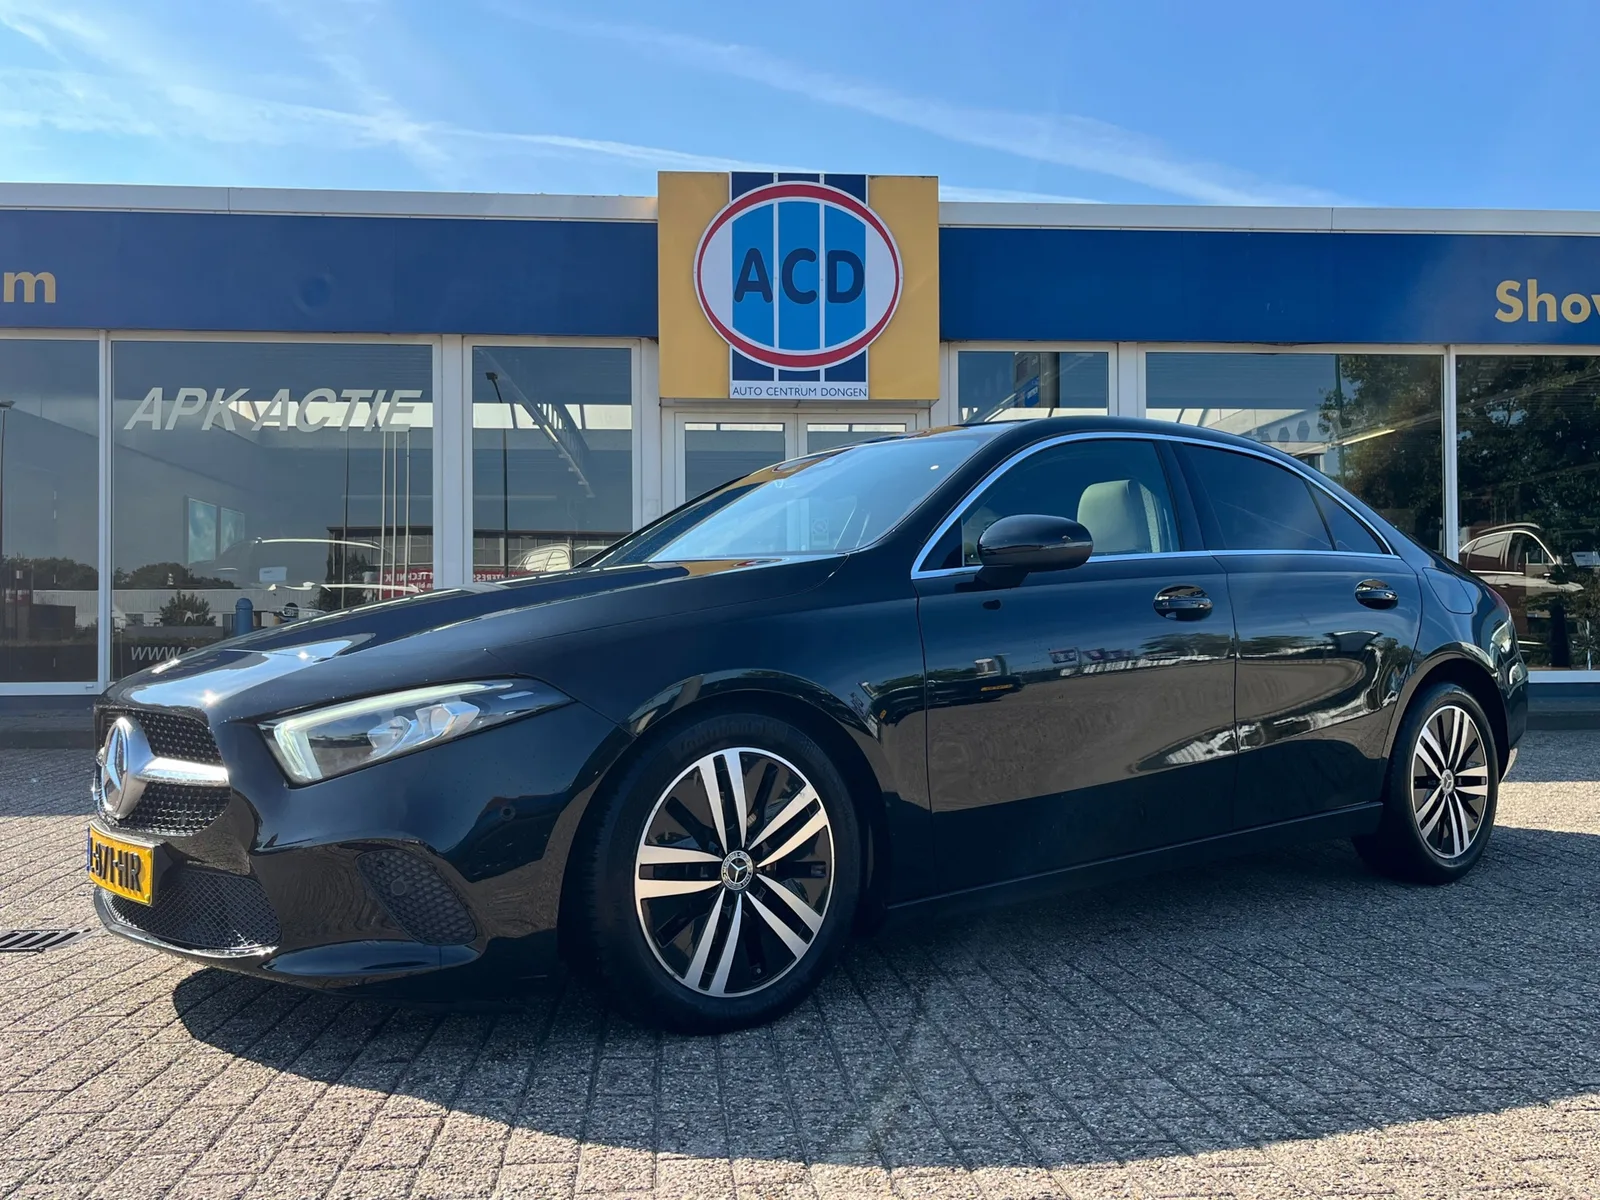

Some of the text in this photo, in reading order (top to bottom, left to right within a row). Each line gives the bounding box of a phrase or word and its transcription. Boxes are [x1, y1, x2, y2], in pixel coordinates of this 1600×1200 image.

[734, 247, 866, 304] ACD
[1494, 278, 1600, 323] Sho
[123, 387, 423, 433] APK ACTIE
[732, 387, 867, 397] AUTO CENTRUM DONGEN
